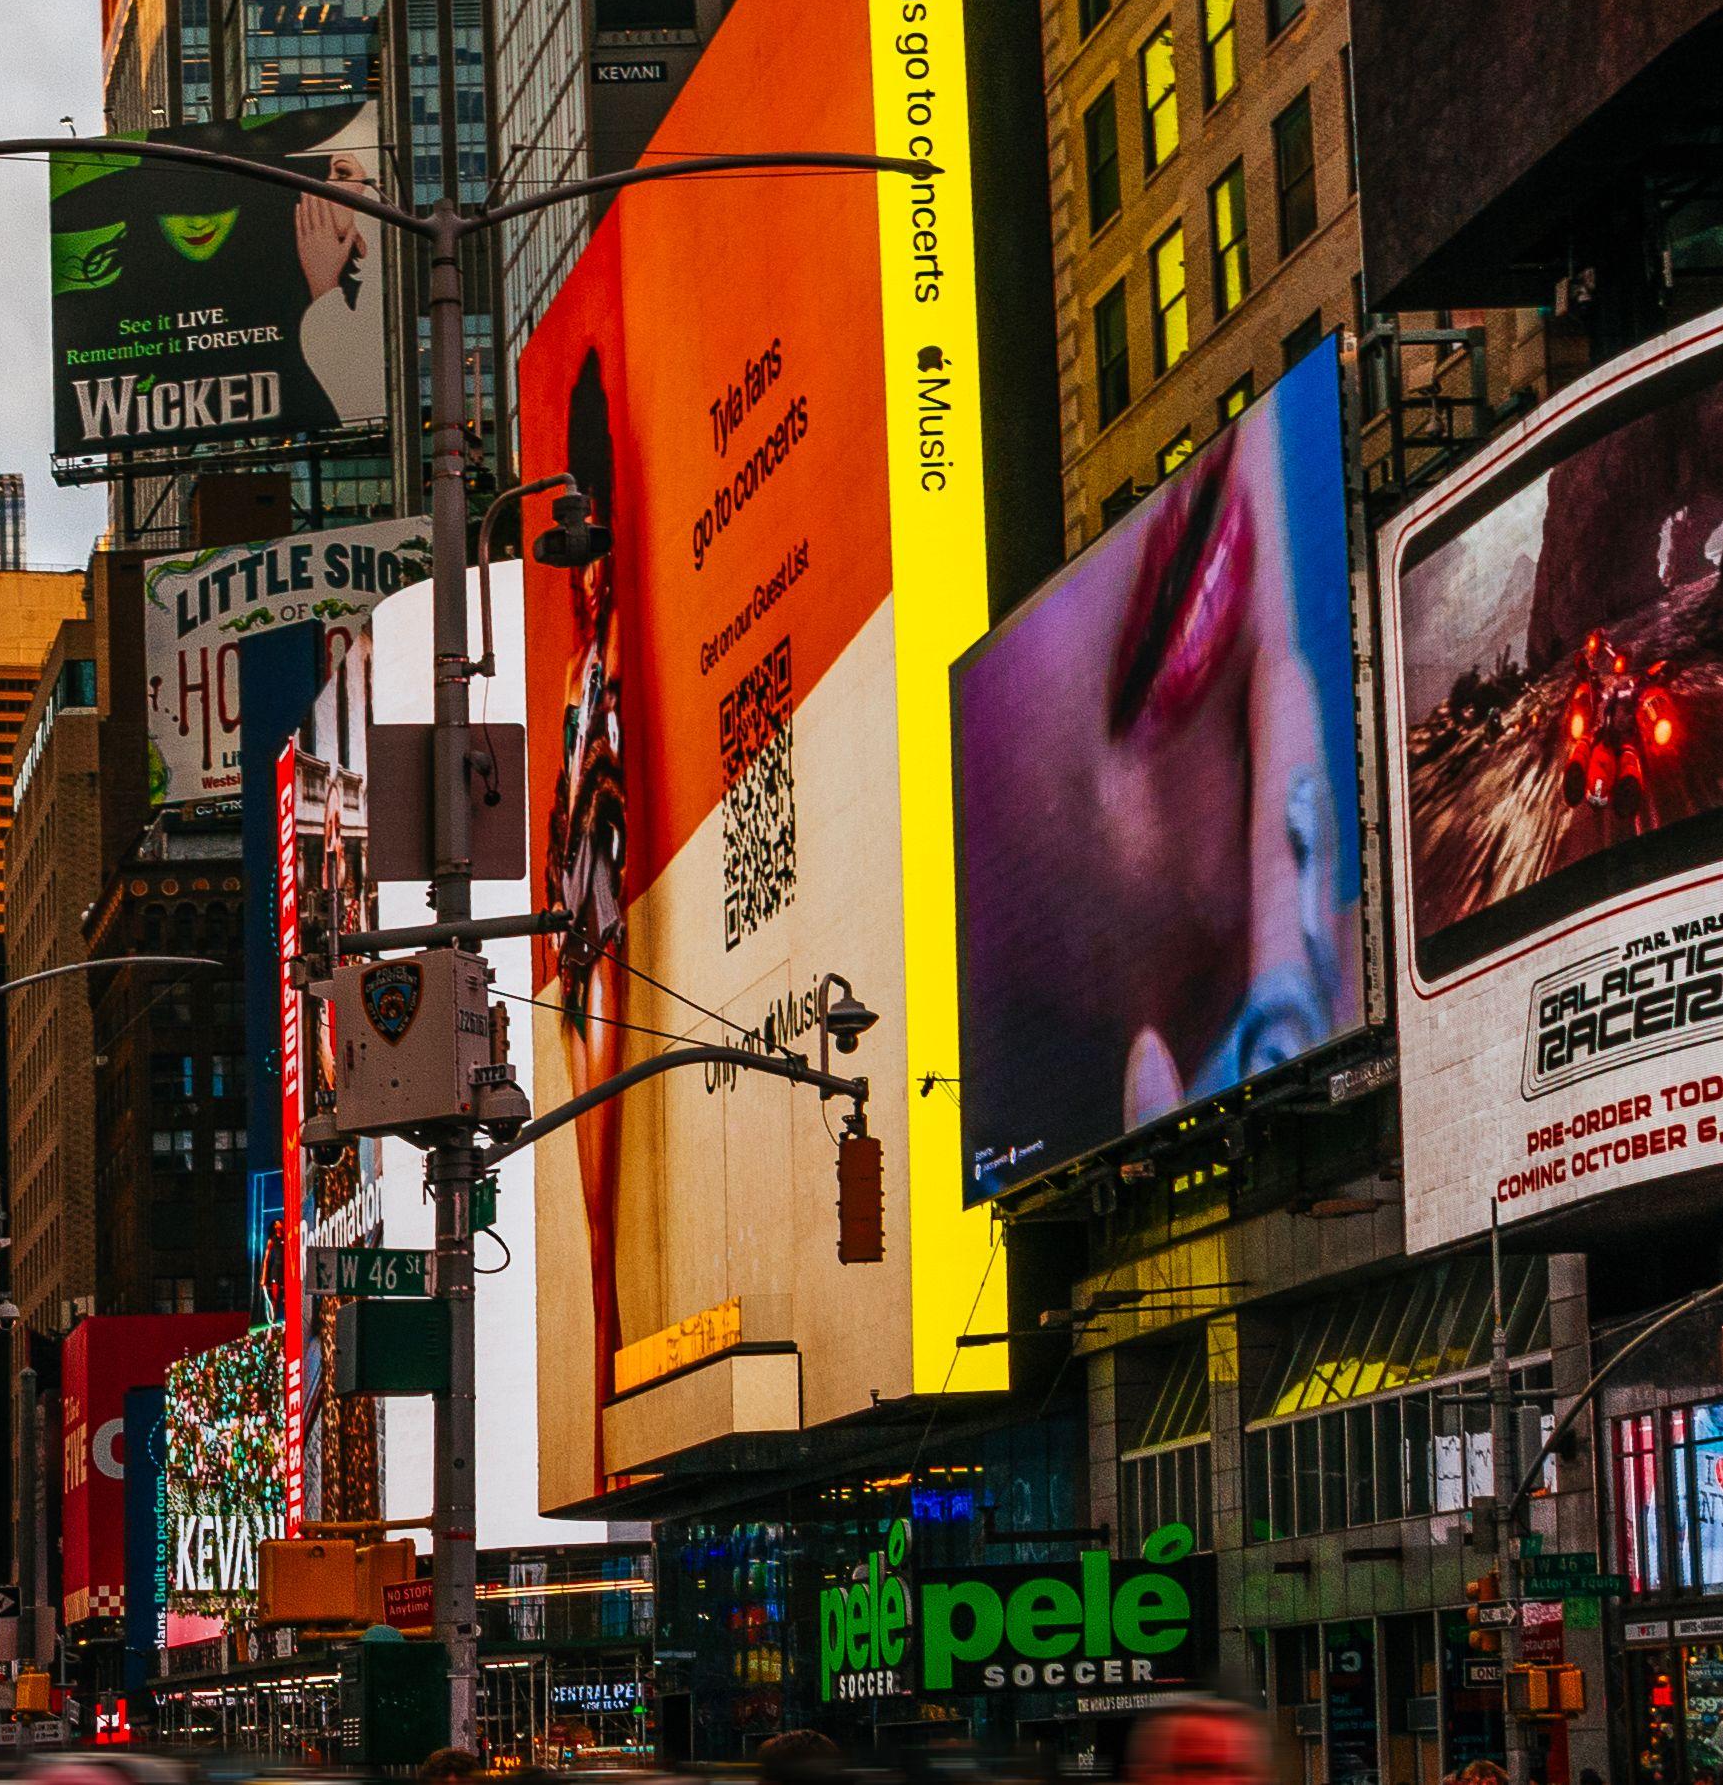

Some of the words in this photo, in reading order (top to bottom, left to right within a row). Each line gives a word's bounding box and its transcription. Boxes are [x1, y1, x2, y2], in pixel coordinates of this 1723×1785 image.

[598, 66, 660, 79] KEVANI
[895, 32, 929, 81] go
[905, 89, 933, 127] to
[118, 319, 152, 335] See
[157, 315, 171, 330] it
[177, 309, 229, 329] LIVE.
[67, 341, 163, 364] Remember
[168, 337, 181, 353] it
[186, 326, 284, 352] FOREVER.
[709, 383, 744, 458] Tyla
[744, 337, 782, 412] fans
[916, 377, 950, 492] Music
[693, 507, 713, 571] go
[714, 486, 731, 534] to
[733, 395, 808, 512] concerts
[176, 543, 314, 639] LITTLE
[323, 543, 402, 595] SHO
[700, 634, 720, 676] Get
[719, 624, 734, 655] on
[734, 602, 752, 641] our
[753, 560, 788, 621] Guest
[788, 537, 810, 586] List
[280, 604, 308, 621] OF
[202, 772, 241, 789] Westsi
[279, 783, 297, 919] COME
[1622, 931, 1670, 961] STAR
[777, 973, 818, 1048] Musi
[474, 1065, 505, 1083] NYPD
[1527, 1094, 1652, 1156] PRE-ORDER
[1660, 1075, 1723, 1111] TOD
[1497, 1159, 1566, 1202] COMING
[1571, 1124, 1686, 1177] OCTOBER
[342, 1255, 359, 1289] W
[368, 1257, 397, 1290] 46
[405, 1255, 420, 1275] St
[155, 1470, 167, 1539] perform.
[155, 1542, 167, 1562] to
[154, 1566, 167, 1603] Built
[388, 1589, 402, 1602] NO
[1530, 1577, 1572, 1590] Actors
[1580, 1577, 1622, 1592] Equity
[389, 1602, 429, 1616] Anytime
[820, 1517, 913, 1703] pelé
[920, 1521, 1194, 1691] pelé
[550, 1683, 612, 1702] CENTRAL
[839, 1670, 895, 1700] SOCCER
[984, 1660, 1154, 1689] SOCCER
